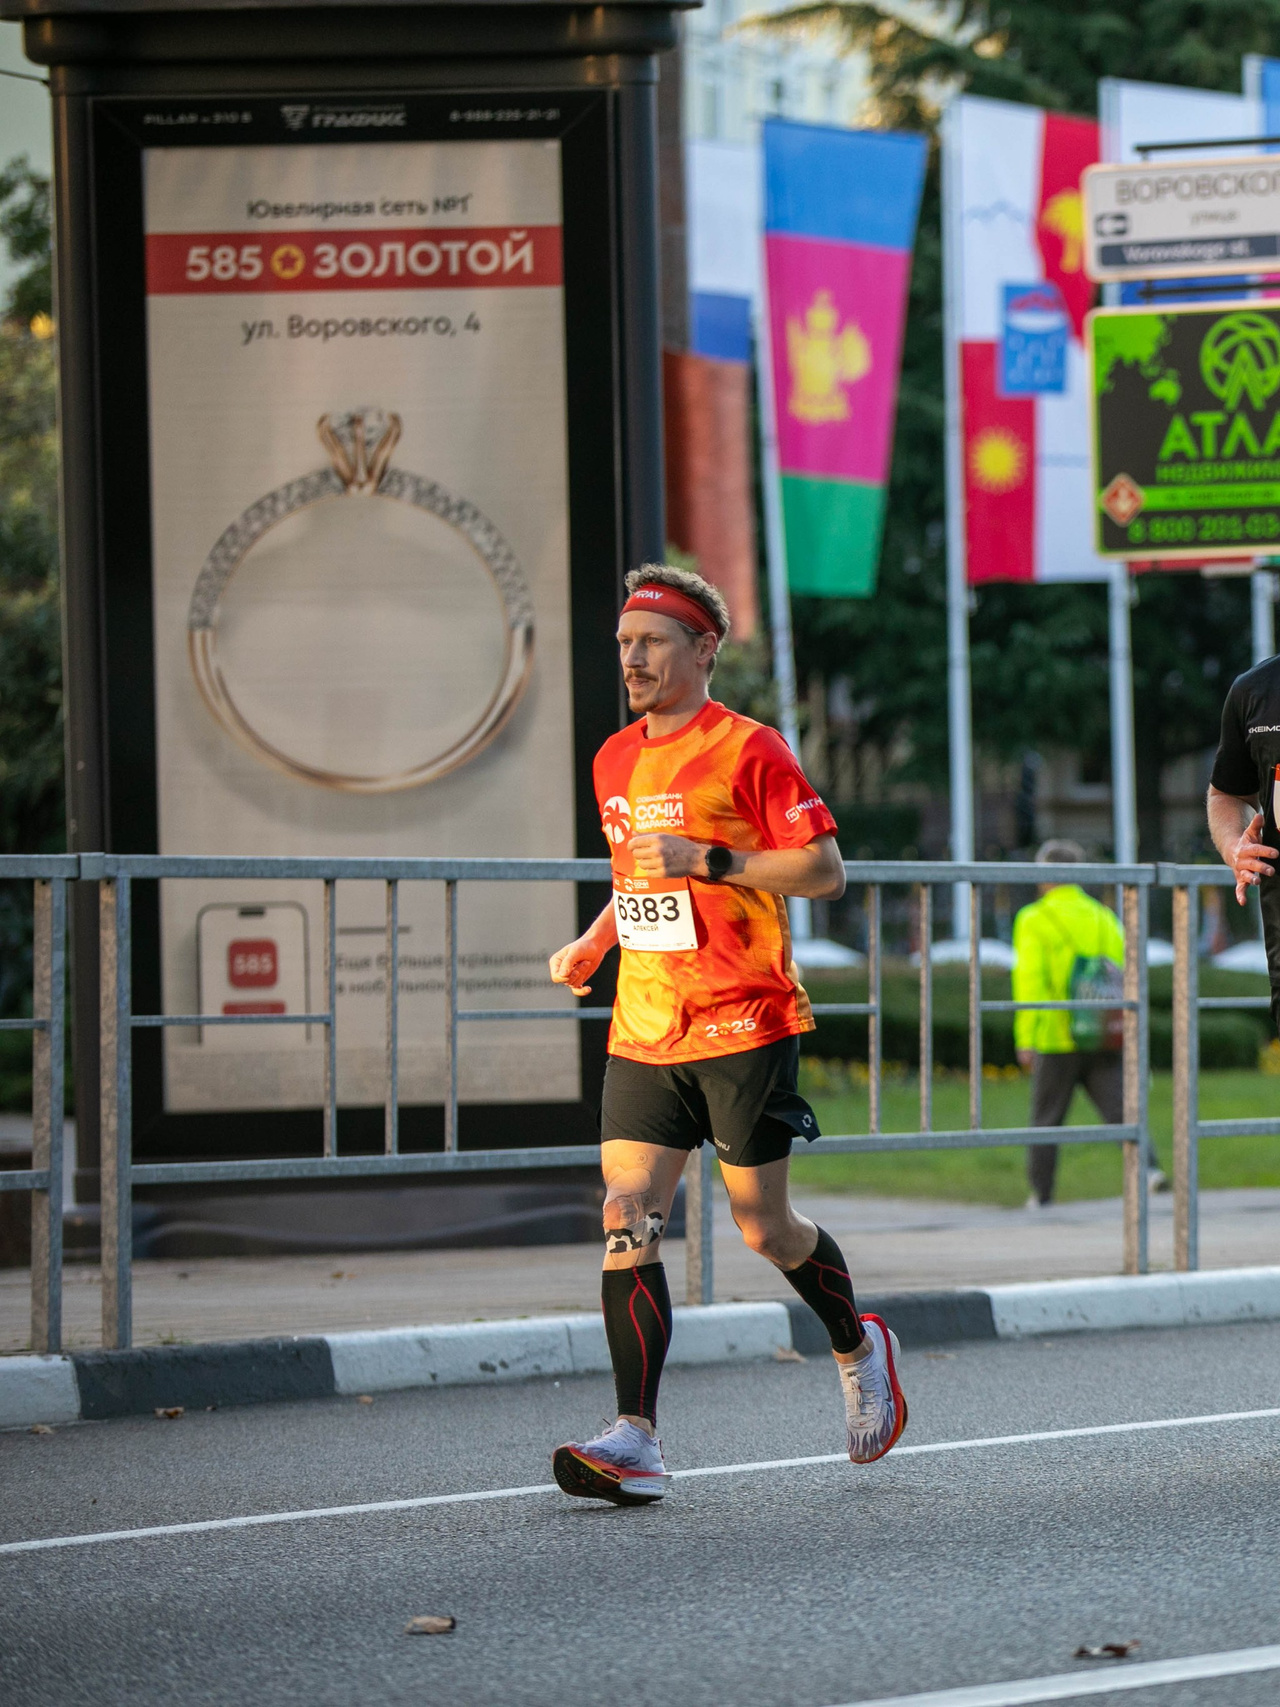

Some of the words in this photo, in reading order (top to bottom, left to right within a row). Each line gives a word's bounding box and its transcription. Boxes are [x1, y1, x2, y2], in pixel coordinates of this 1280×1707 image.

[247, 199, 375, 221] Ювелирная
[380, 197, 427, 217] сеть
[186, 245, 264, 281] 585
[312, 229, 535, 278] ЗОЛОТОЙ
[242, 317, 279, 344] ул.
[287, 312, 458, 340] Воровского,
[463, 313, 481, 333] 4
[635, 802, 684, 820] СОЧИ
[636, 818, 685, 830] МАРАФОН
[617, 895, 680, 923] 6383
[232, 952, 275, 975] 585
